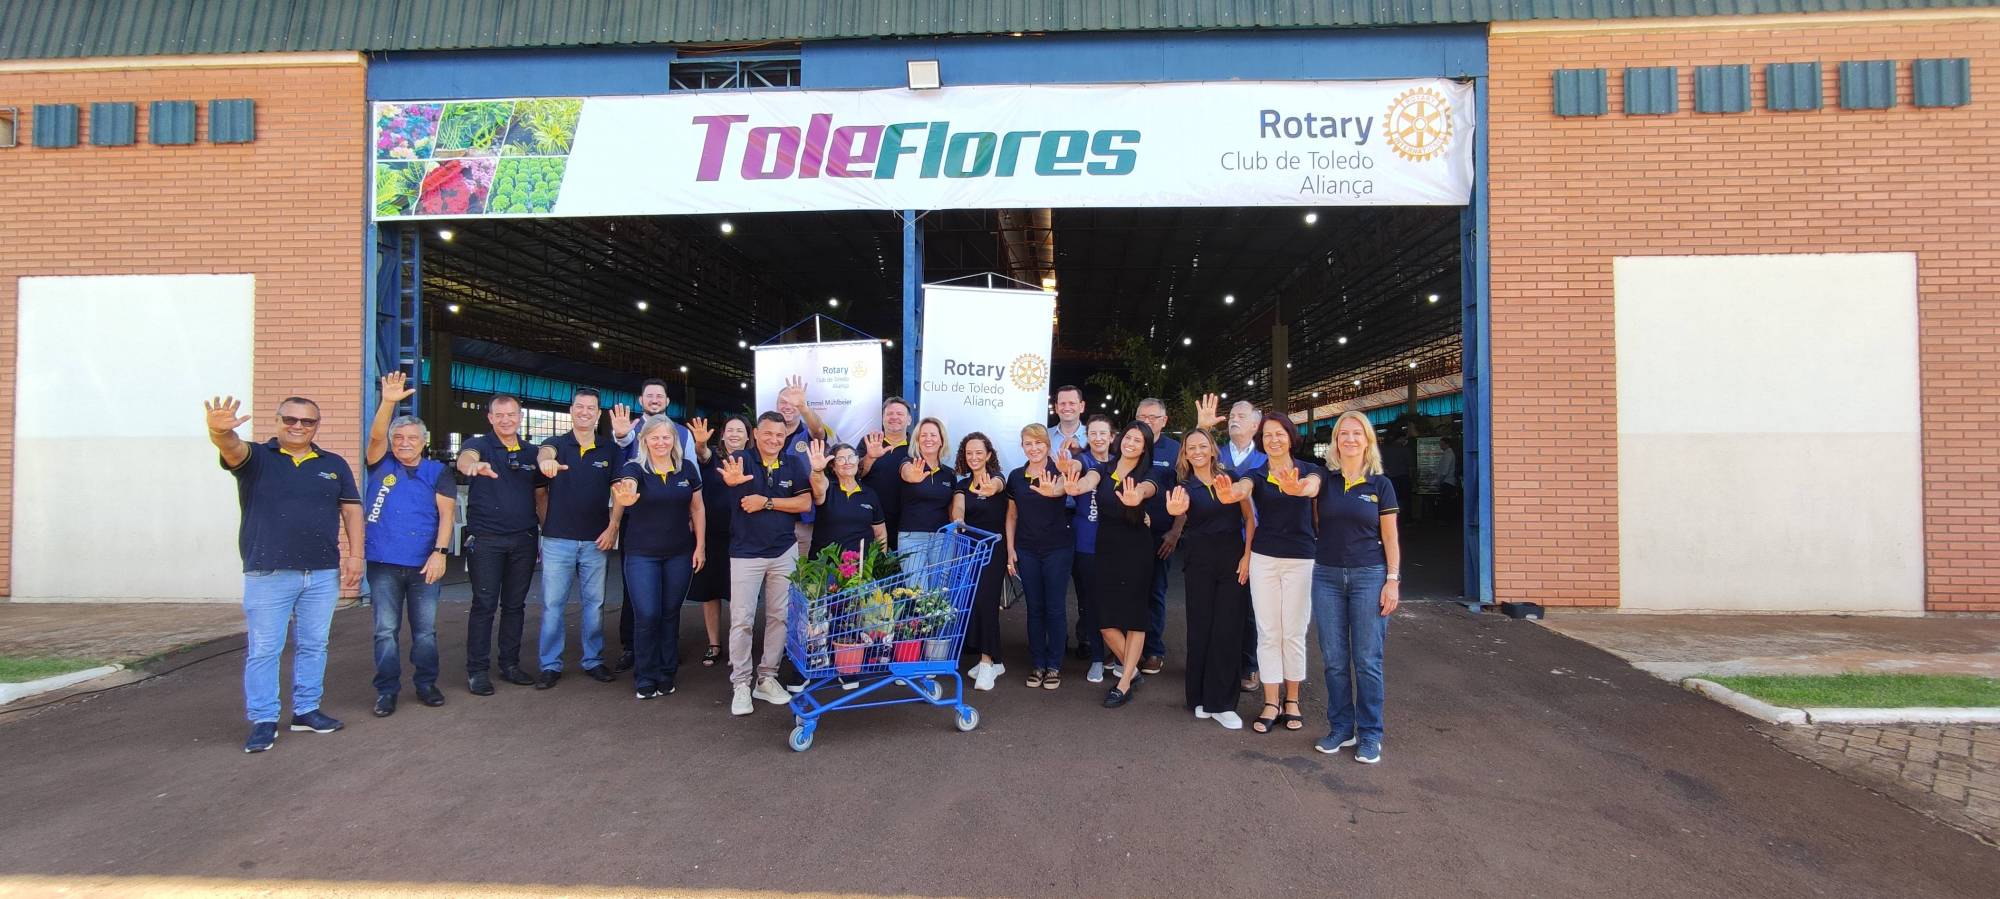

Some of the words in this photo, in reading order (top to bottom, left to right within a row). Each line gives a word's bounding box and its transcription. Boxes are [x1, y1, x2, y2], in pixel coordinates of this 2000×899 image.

[1259, 109, 1374, 146] Rotary
[692, 113, 1141, 182] ToleFlores
[1220, 150, 1268, 170] Club
[1276, 150, 1301, 170] de
[1307, 151, 1374, 170] Toledo
[1299, 174, 1373, 199] Aliança
[822, 366, 849, 375] Rotary
[944, 359, 1006, 381] Rotary
[922, 381, 948, 392] Club
[951, 381, 965, 393] de
[968, 382, 1005, 395] Toledo
[963, 395, 1004, 409] Aliança
[367, 485, 390, 523] Rotary
